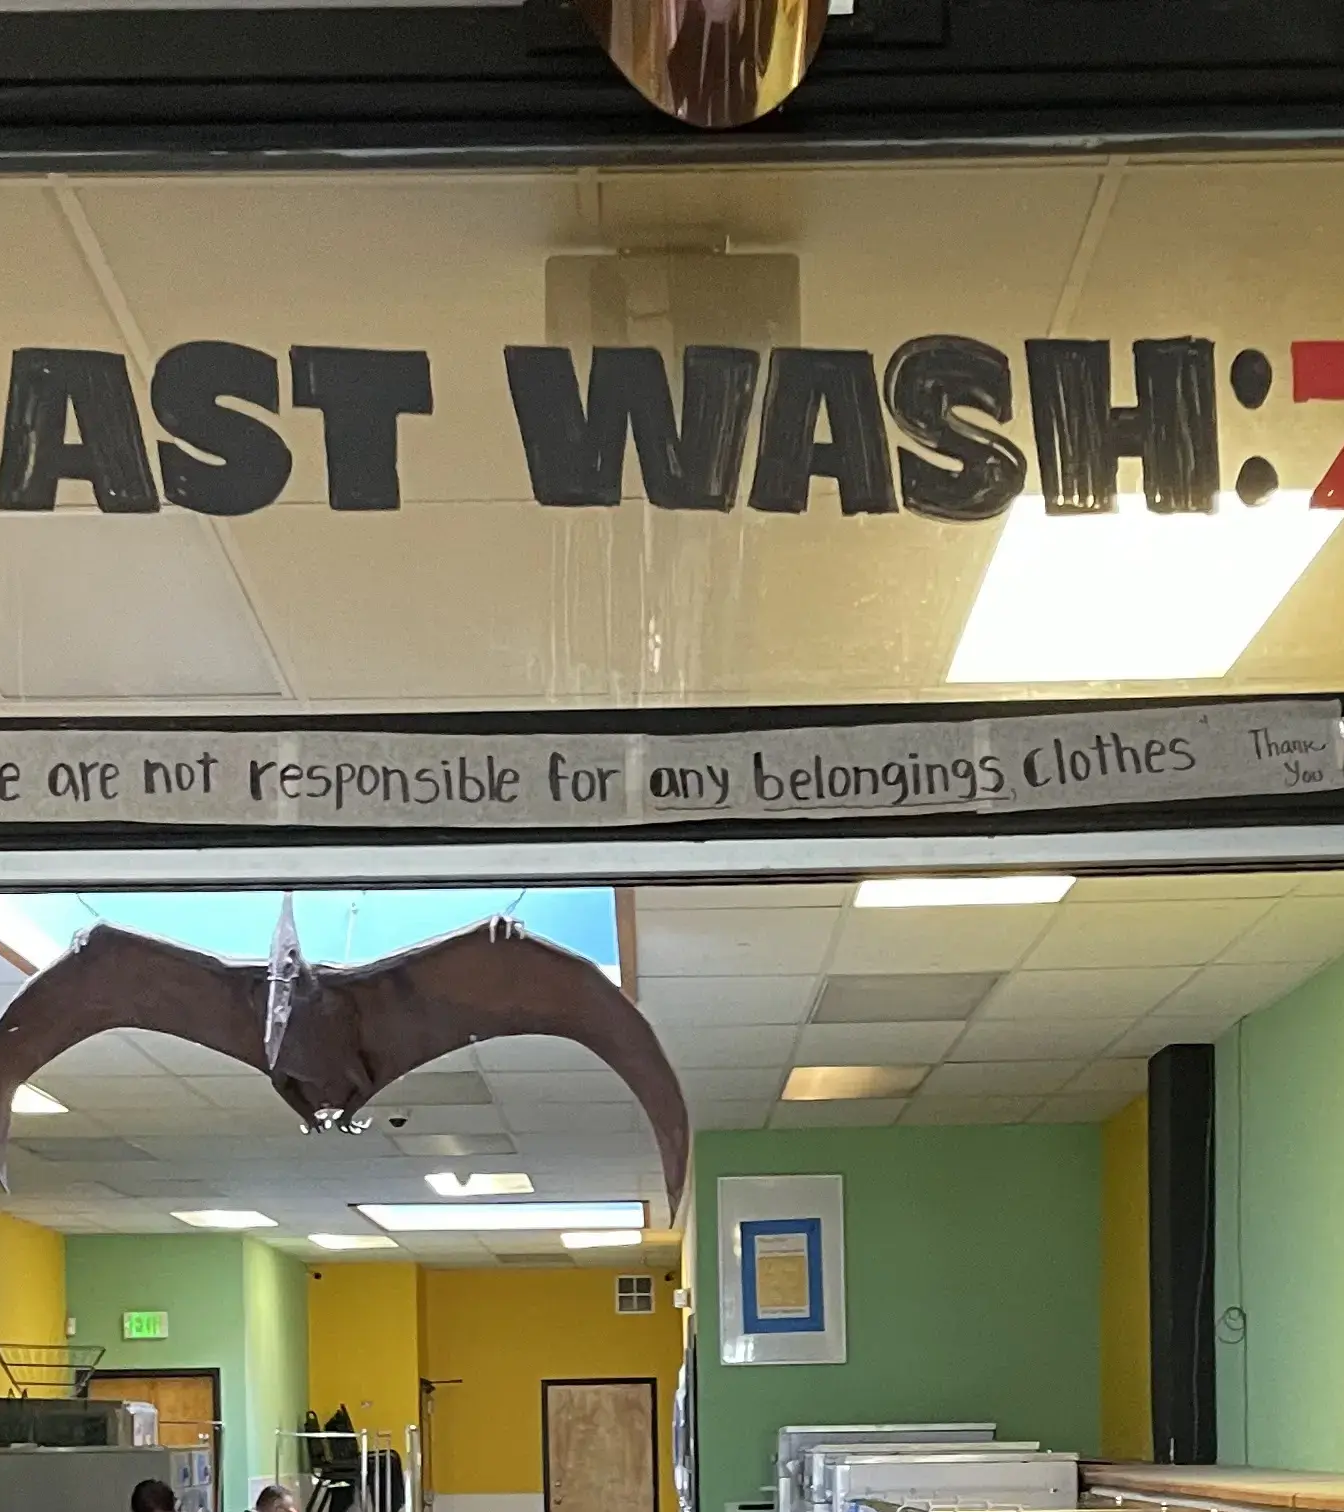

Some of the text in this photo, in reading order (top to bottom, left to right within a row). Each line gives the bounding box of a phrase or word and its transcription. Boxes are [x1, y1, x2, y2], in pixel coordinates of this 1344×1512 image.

[1248, 727, 1328, 761] Thank
[47, 757, 119, 801] are
[144, 752, 215, 798] not
[250, 752, 522, 814] responsible
[549, 757, 622, 806] for
[649, 766, 730, 804] any
[1284, 759, 1324, 788] You
